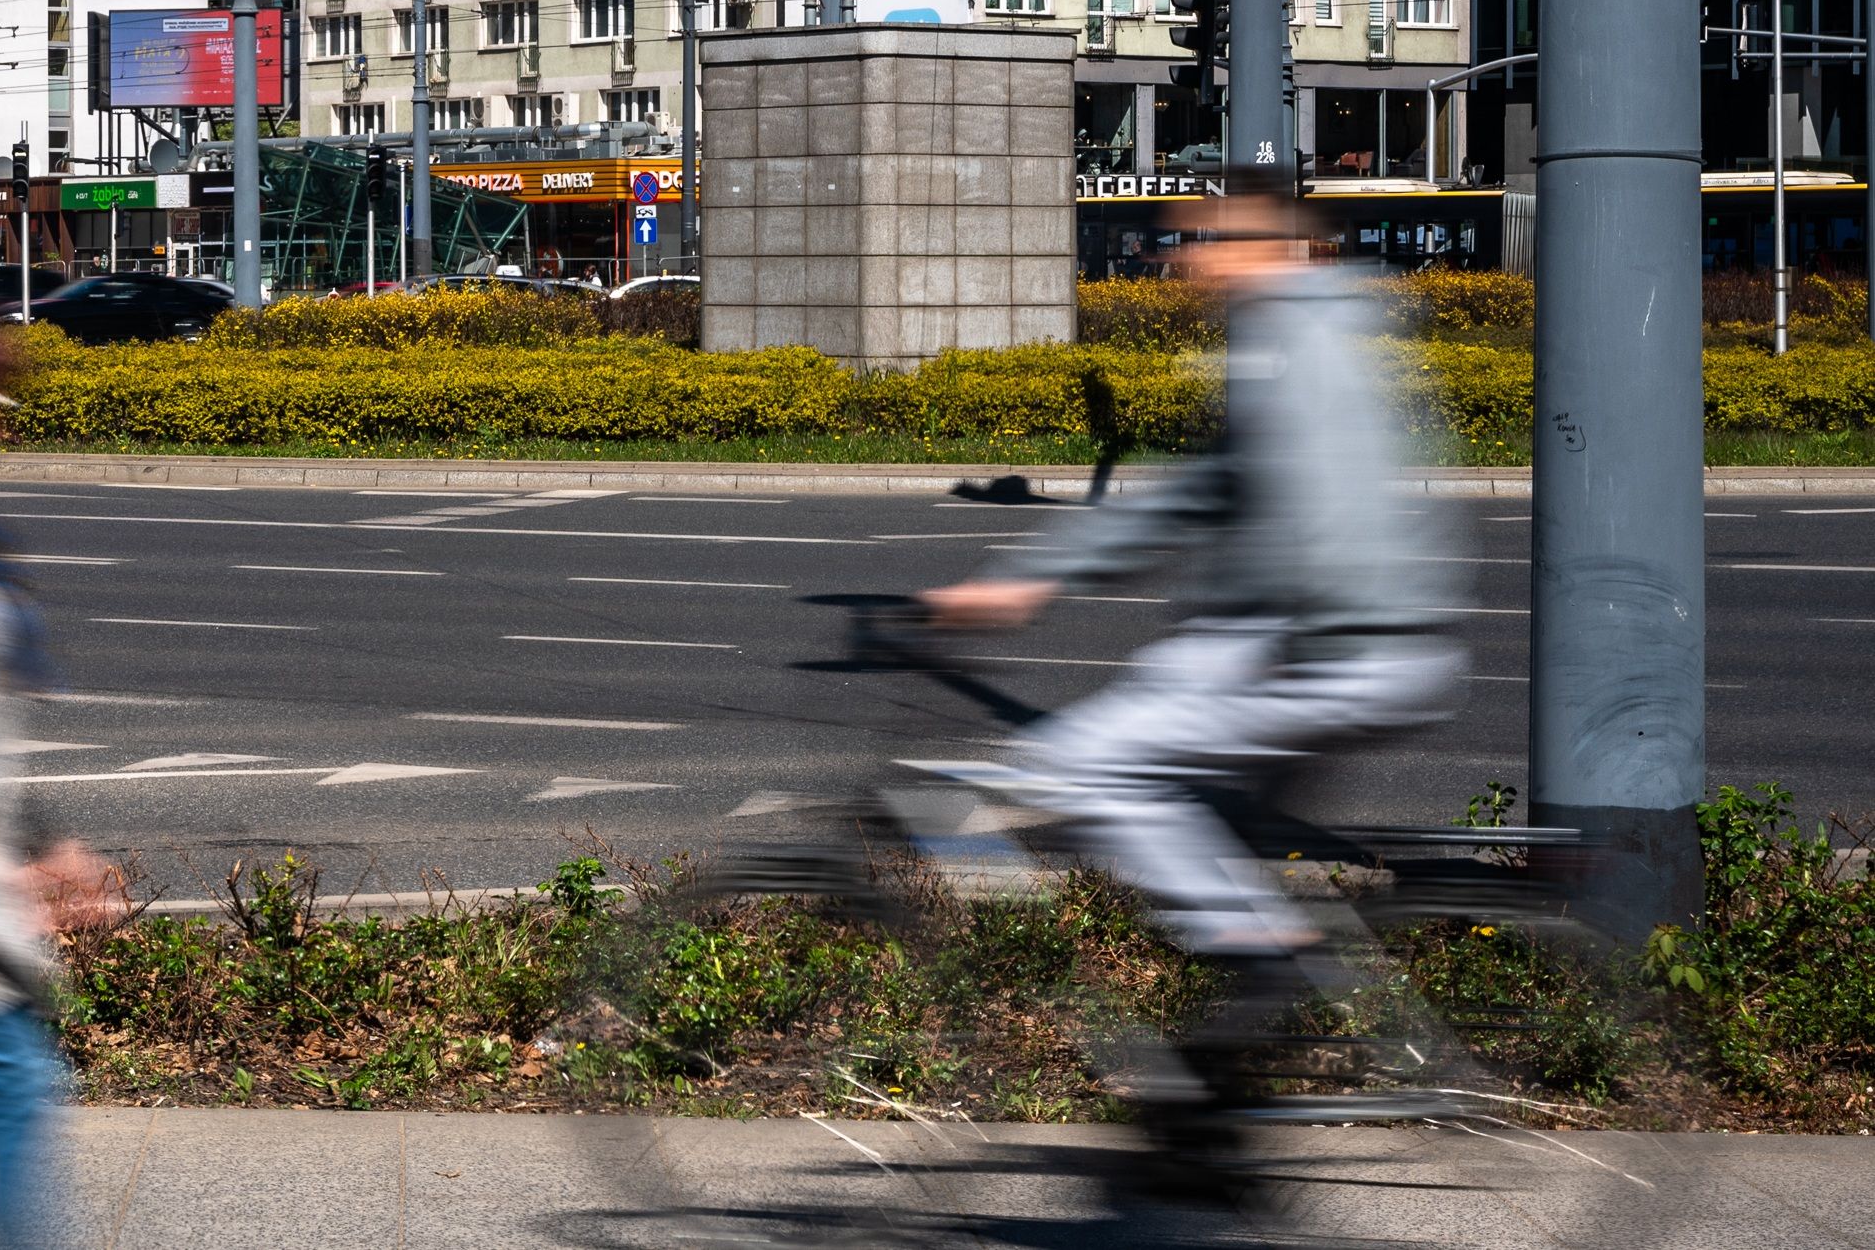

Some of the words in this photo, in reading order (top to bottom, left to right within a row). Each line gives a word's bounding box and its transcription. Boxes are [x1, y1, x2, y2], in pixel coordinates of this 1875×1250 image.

[1259, 141, 1272, 153] 16
[1256, 151, 1275, 163] 226
[479, 173, 523, 191] PIZZA
[543, 171, 595, 189] DELIVERY
